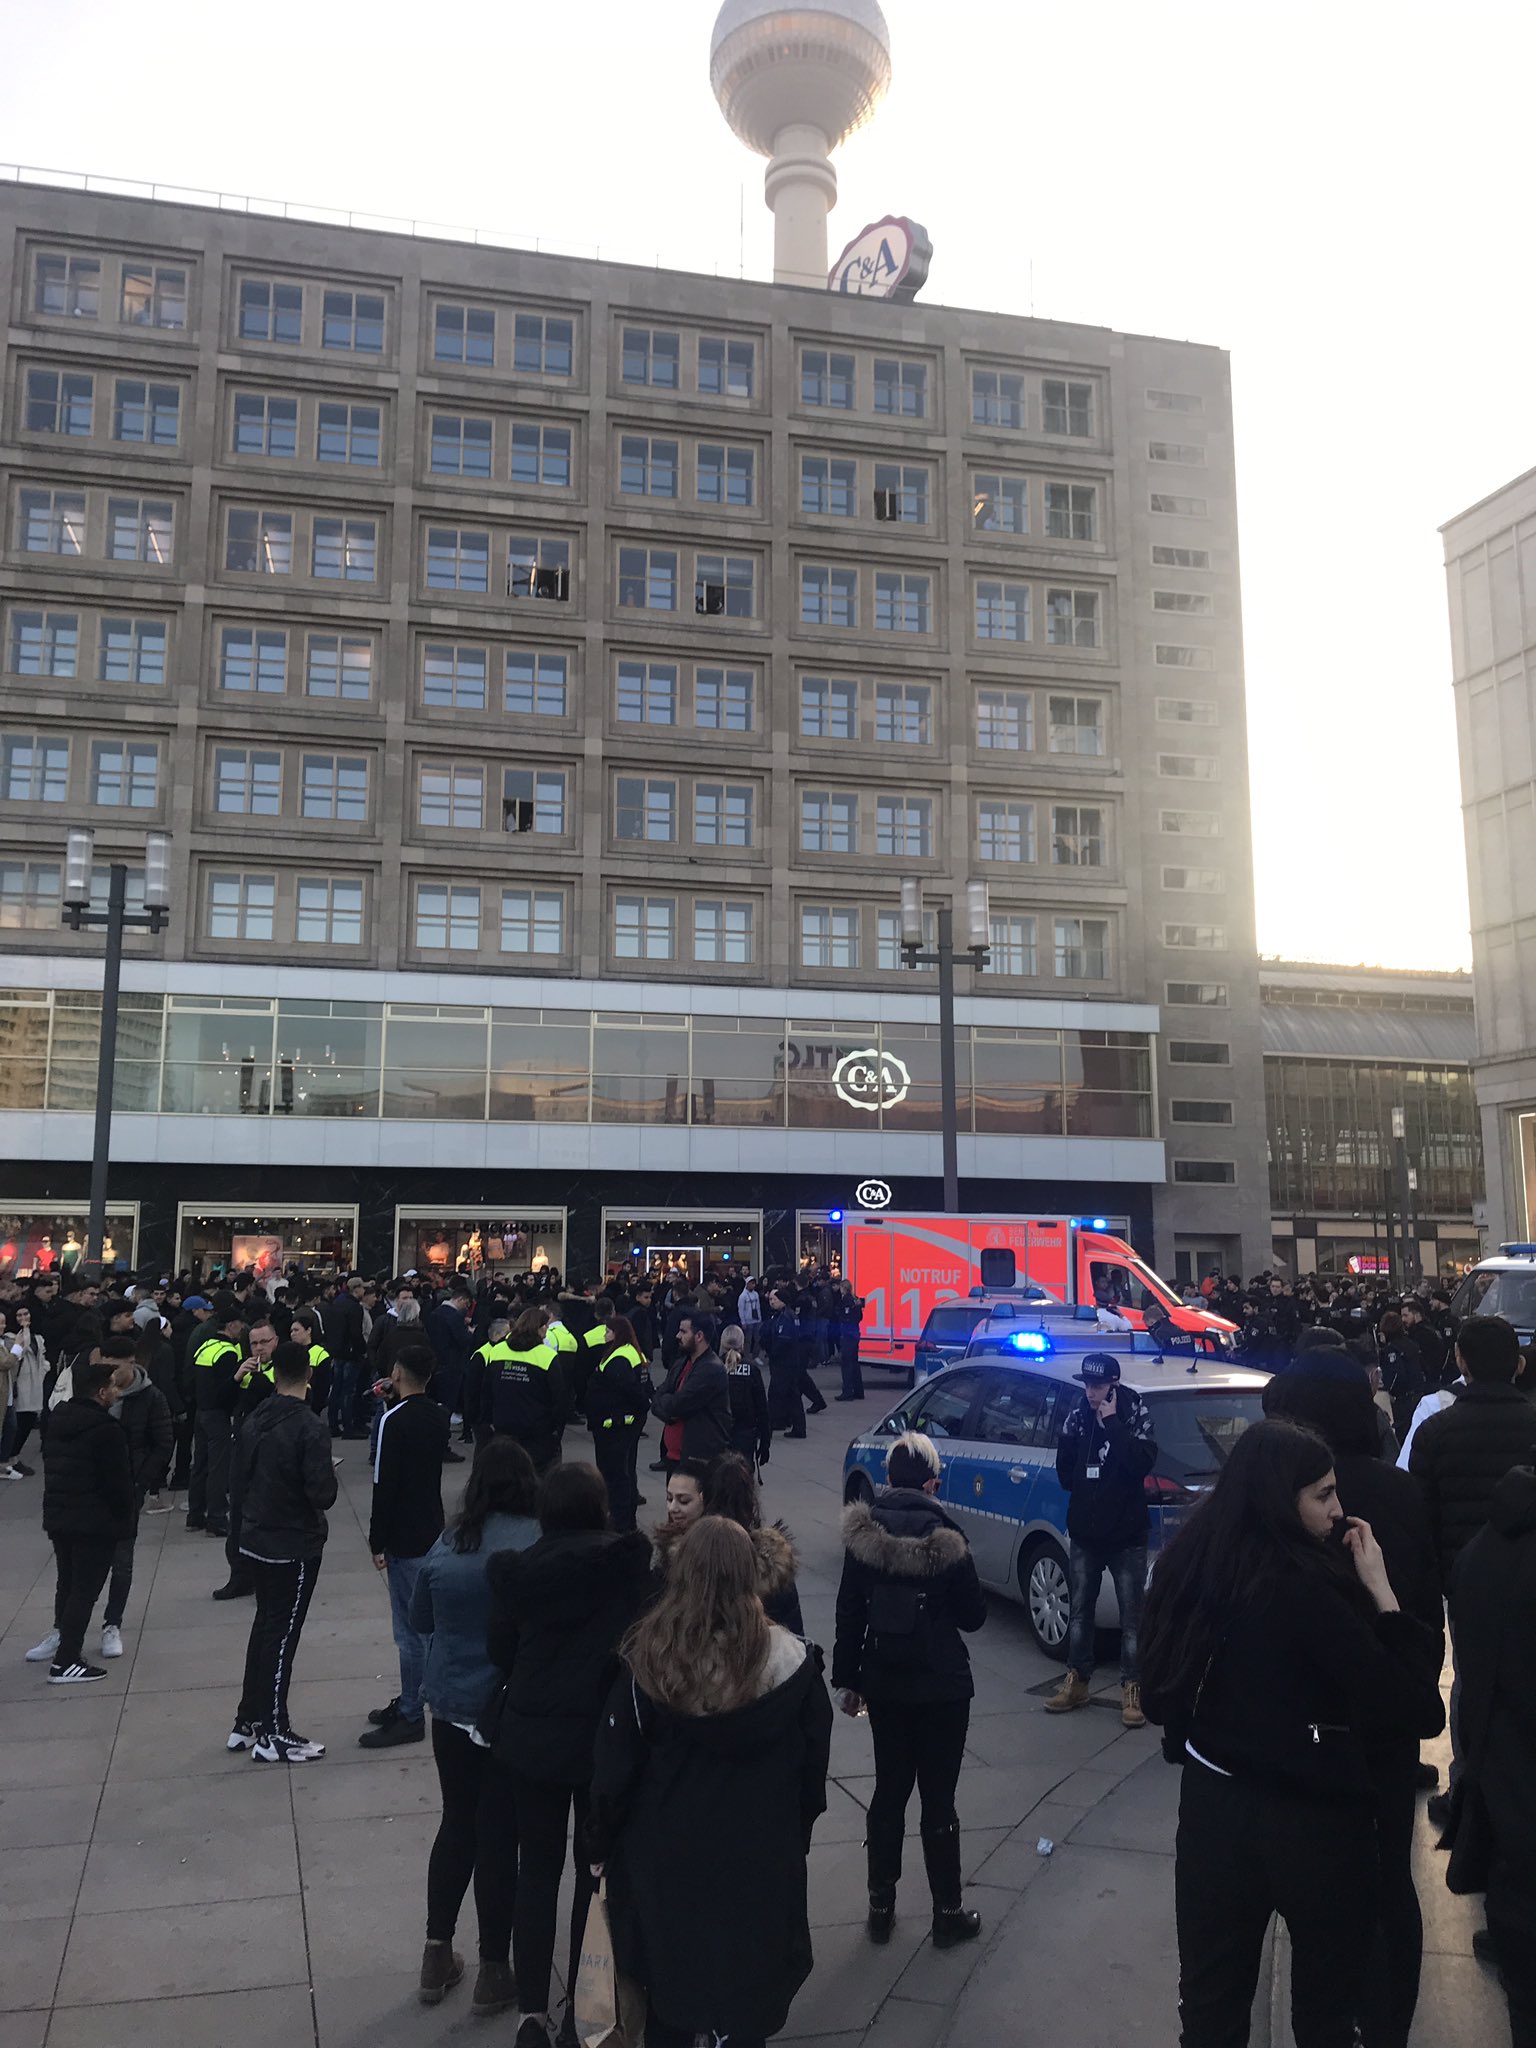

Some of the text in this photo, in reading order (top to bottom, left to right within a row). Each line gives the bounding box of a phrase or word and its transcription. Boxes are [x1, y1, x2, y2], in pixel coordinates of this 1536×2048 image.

[839, 237, 899, 294] C&A
[847, 1065, 897, 1093] C&A
[862, 1187, 885, 1201] C&A
[463, 1223, 557, 1234] CLOCKHOUSE
[1008, 1236, 1063, 1248] FEUERWEHR
[900, 1268, 961, 1284] NOTRUF
[1170, 1335, 1192, 1346] POLIZEI
